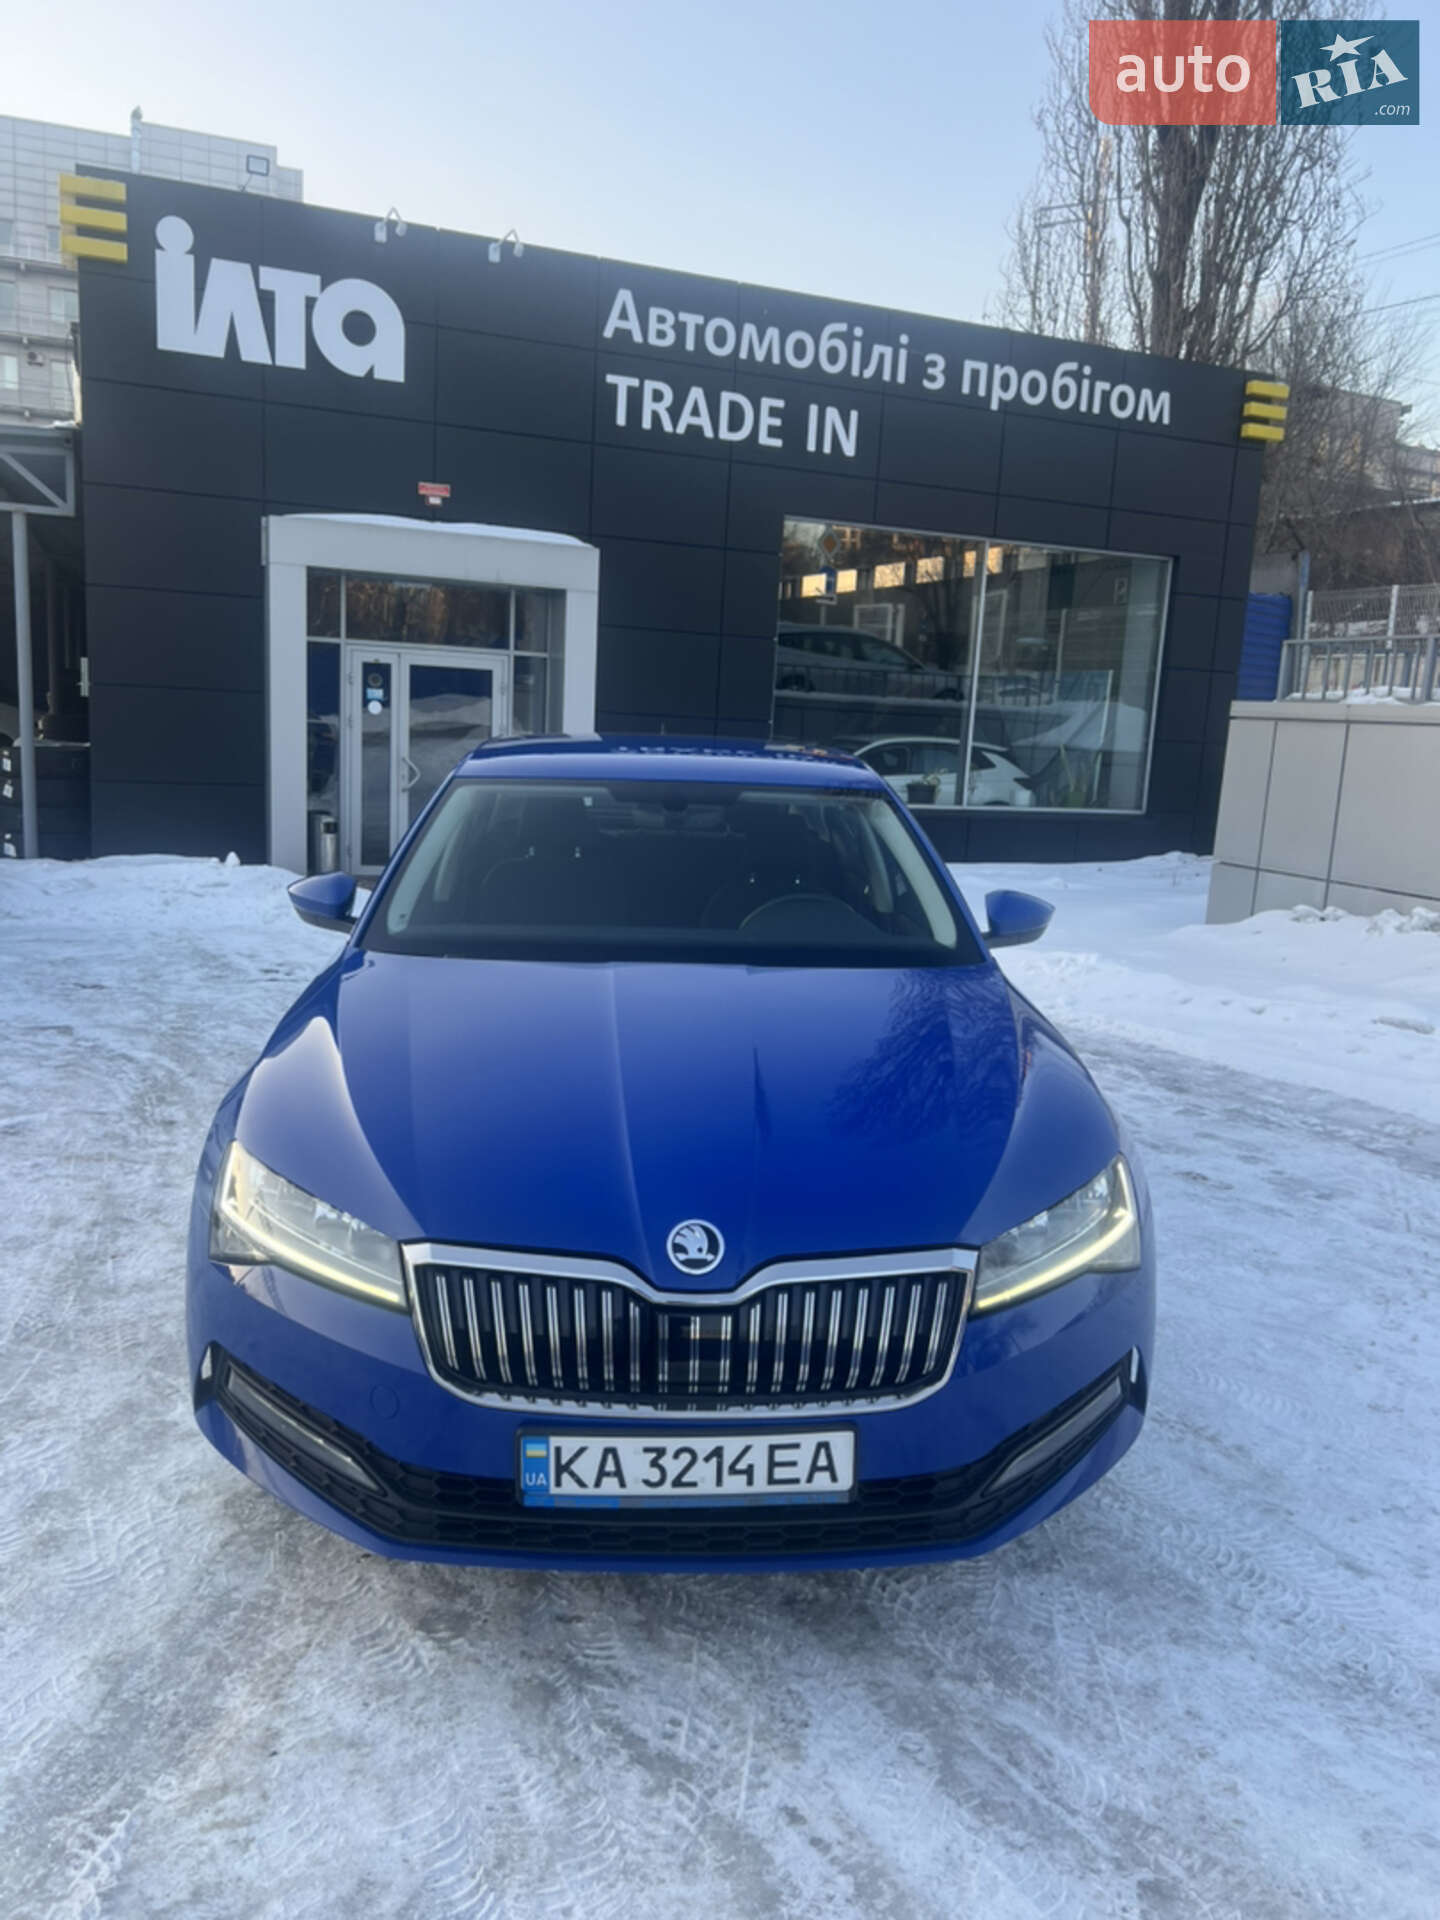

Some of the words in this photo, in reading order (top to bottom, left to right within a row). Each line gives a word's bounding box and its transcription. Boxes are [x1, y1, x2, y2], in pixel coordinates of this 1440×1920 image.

[603, 288, 909, 385] Автомобілі
[922, 353, 946, 390] з
[961, 361, 1171, 425] пробігом
[605, 373, 785, 448] TRADE
[806, 403, 858, 457] IN
[526, 1474, 548, 1487] UA
